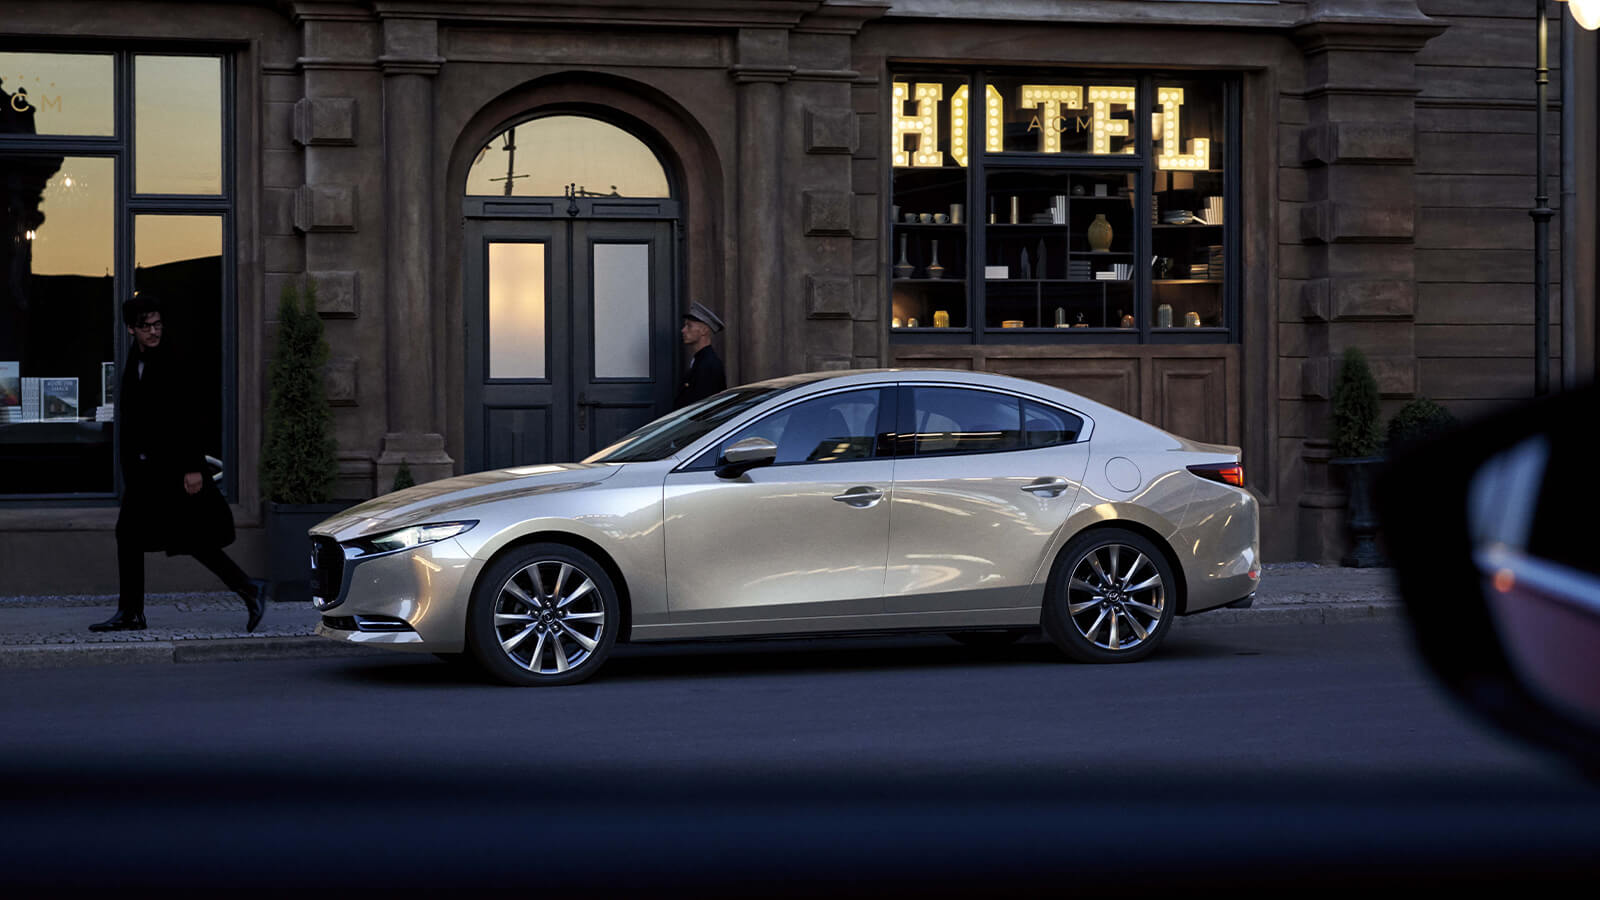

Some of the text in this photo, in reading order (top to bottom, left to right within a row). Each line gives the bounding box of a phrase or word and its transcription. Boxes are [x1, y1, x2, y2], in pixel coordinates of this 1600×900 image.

[0, 92, 62, 112] CM
[892, 82, 1210, 170] HOTEL
[1027, 115, 1093, 133] ACM
